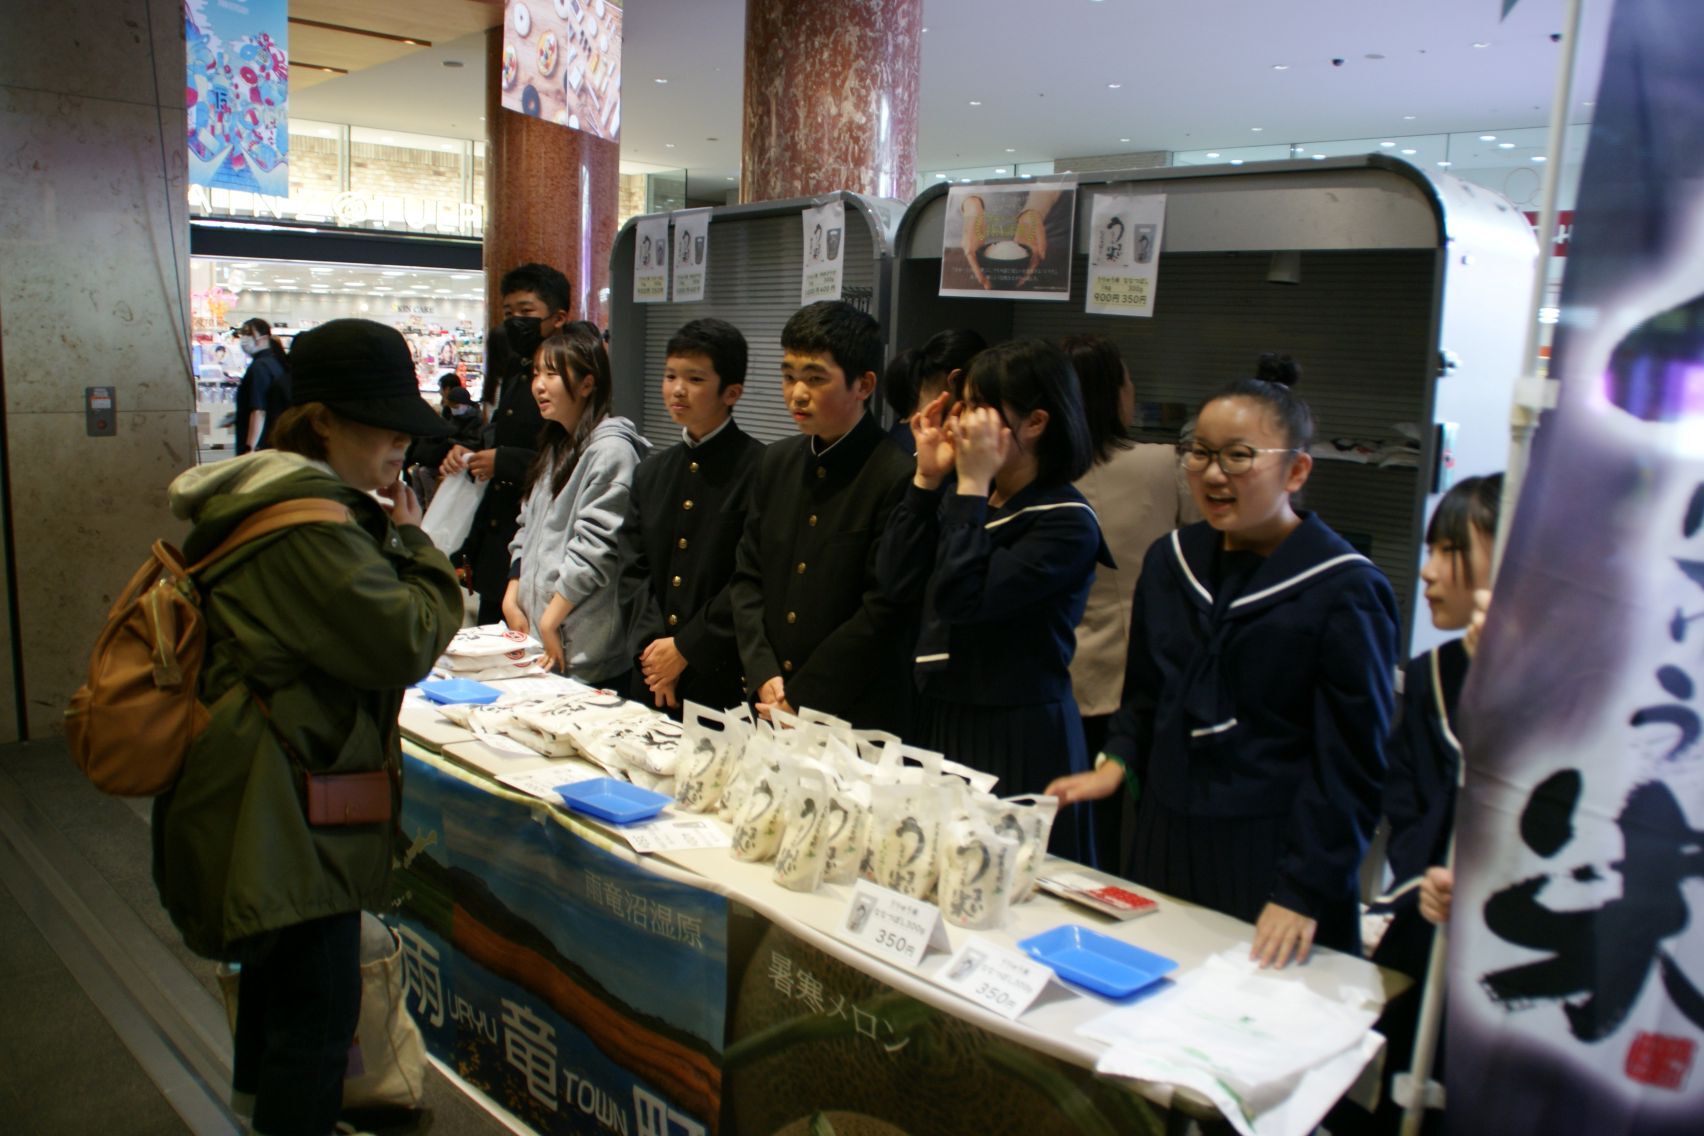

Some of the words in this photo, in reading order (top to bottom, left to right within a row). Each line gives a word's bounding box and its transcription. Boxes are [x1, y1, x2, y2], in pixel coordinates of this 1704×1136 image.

[412, 305, 434, 314] CARE
[1094, 292, 1120, 303] 900円
[1121, 294, 1147, 305] 350円
[583, 867, 704, 951] 雨竜沼湿原
[875, 929, 916, 957] 350円
[768, 950, 911, 1052] 暑寒メロン
[975, 981, 1017, 1009] 350円
[446, 988, 498, 1044] URYU
[500, 998, 558, 1113] 竜
[562, 1066, 628, 1136] TOWN
